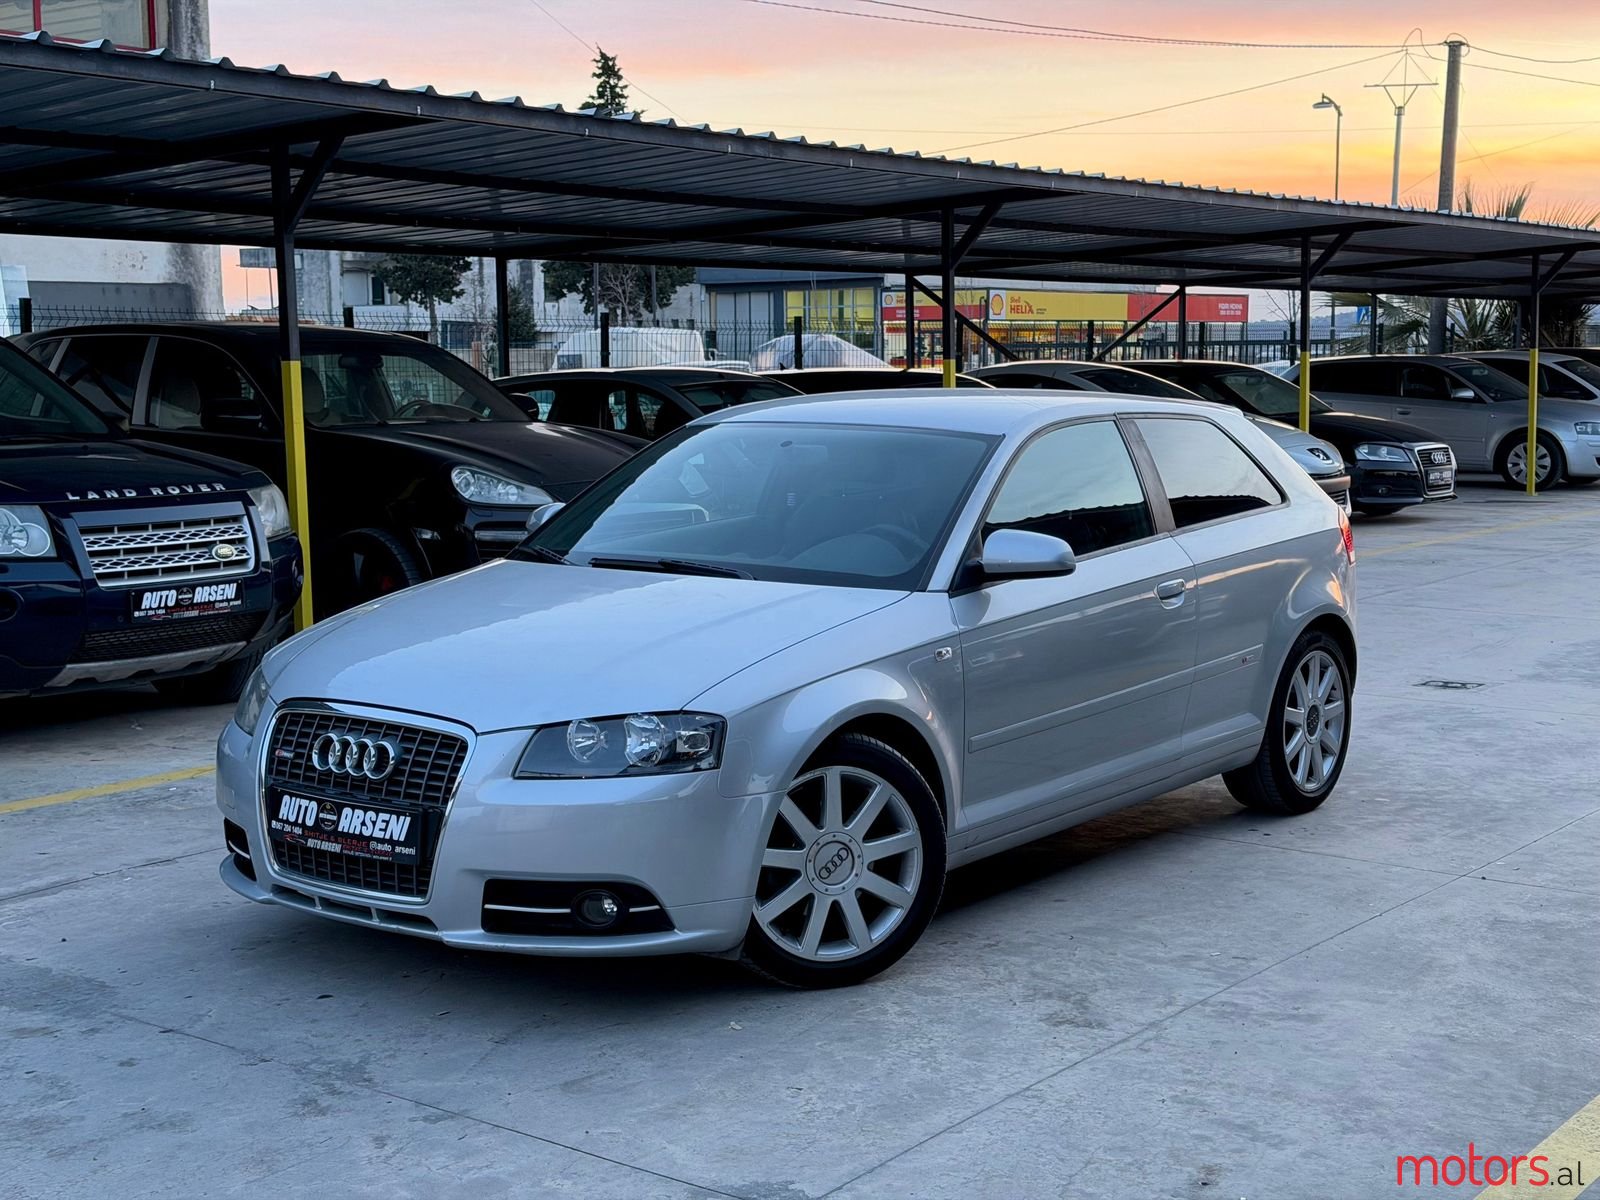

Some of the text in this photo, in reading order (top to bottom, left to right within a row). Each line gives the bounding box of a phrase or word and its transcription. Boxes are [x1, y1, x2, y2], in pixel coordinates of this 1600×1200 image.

[1010, 302, 1034, 315] HELIX
[65, 482, 227, 500] LAND ROVER
[141, 589, 177, 610] AUTO
[193, 583, 237, 603] ARSENI
[279, 794, 411, 841] AUTO ARSENI
